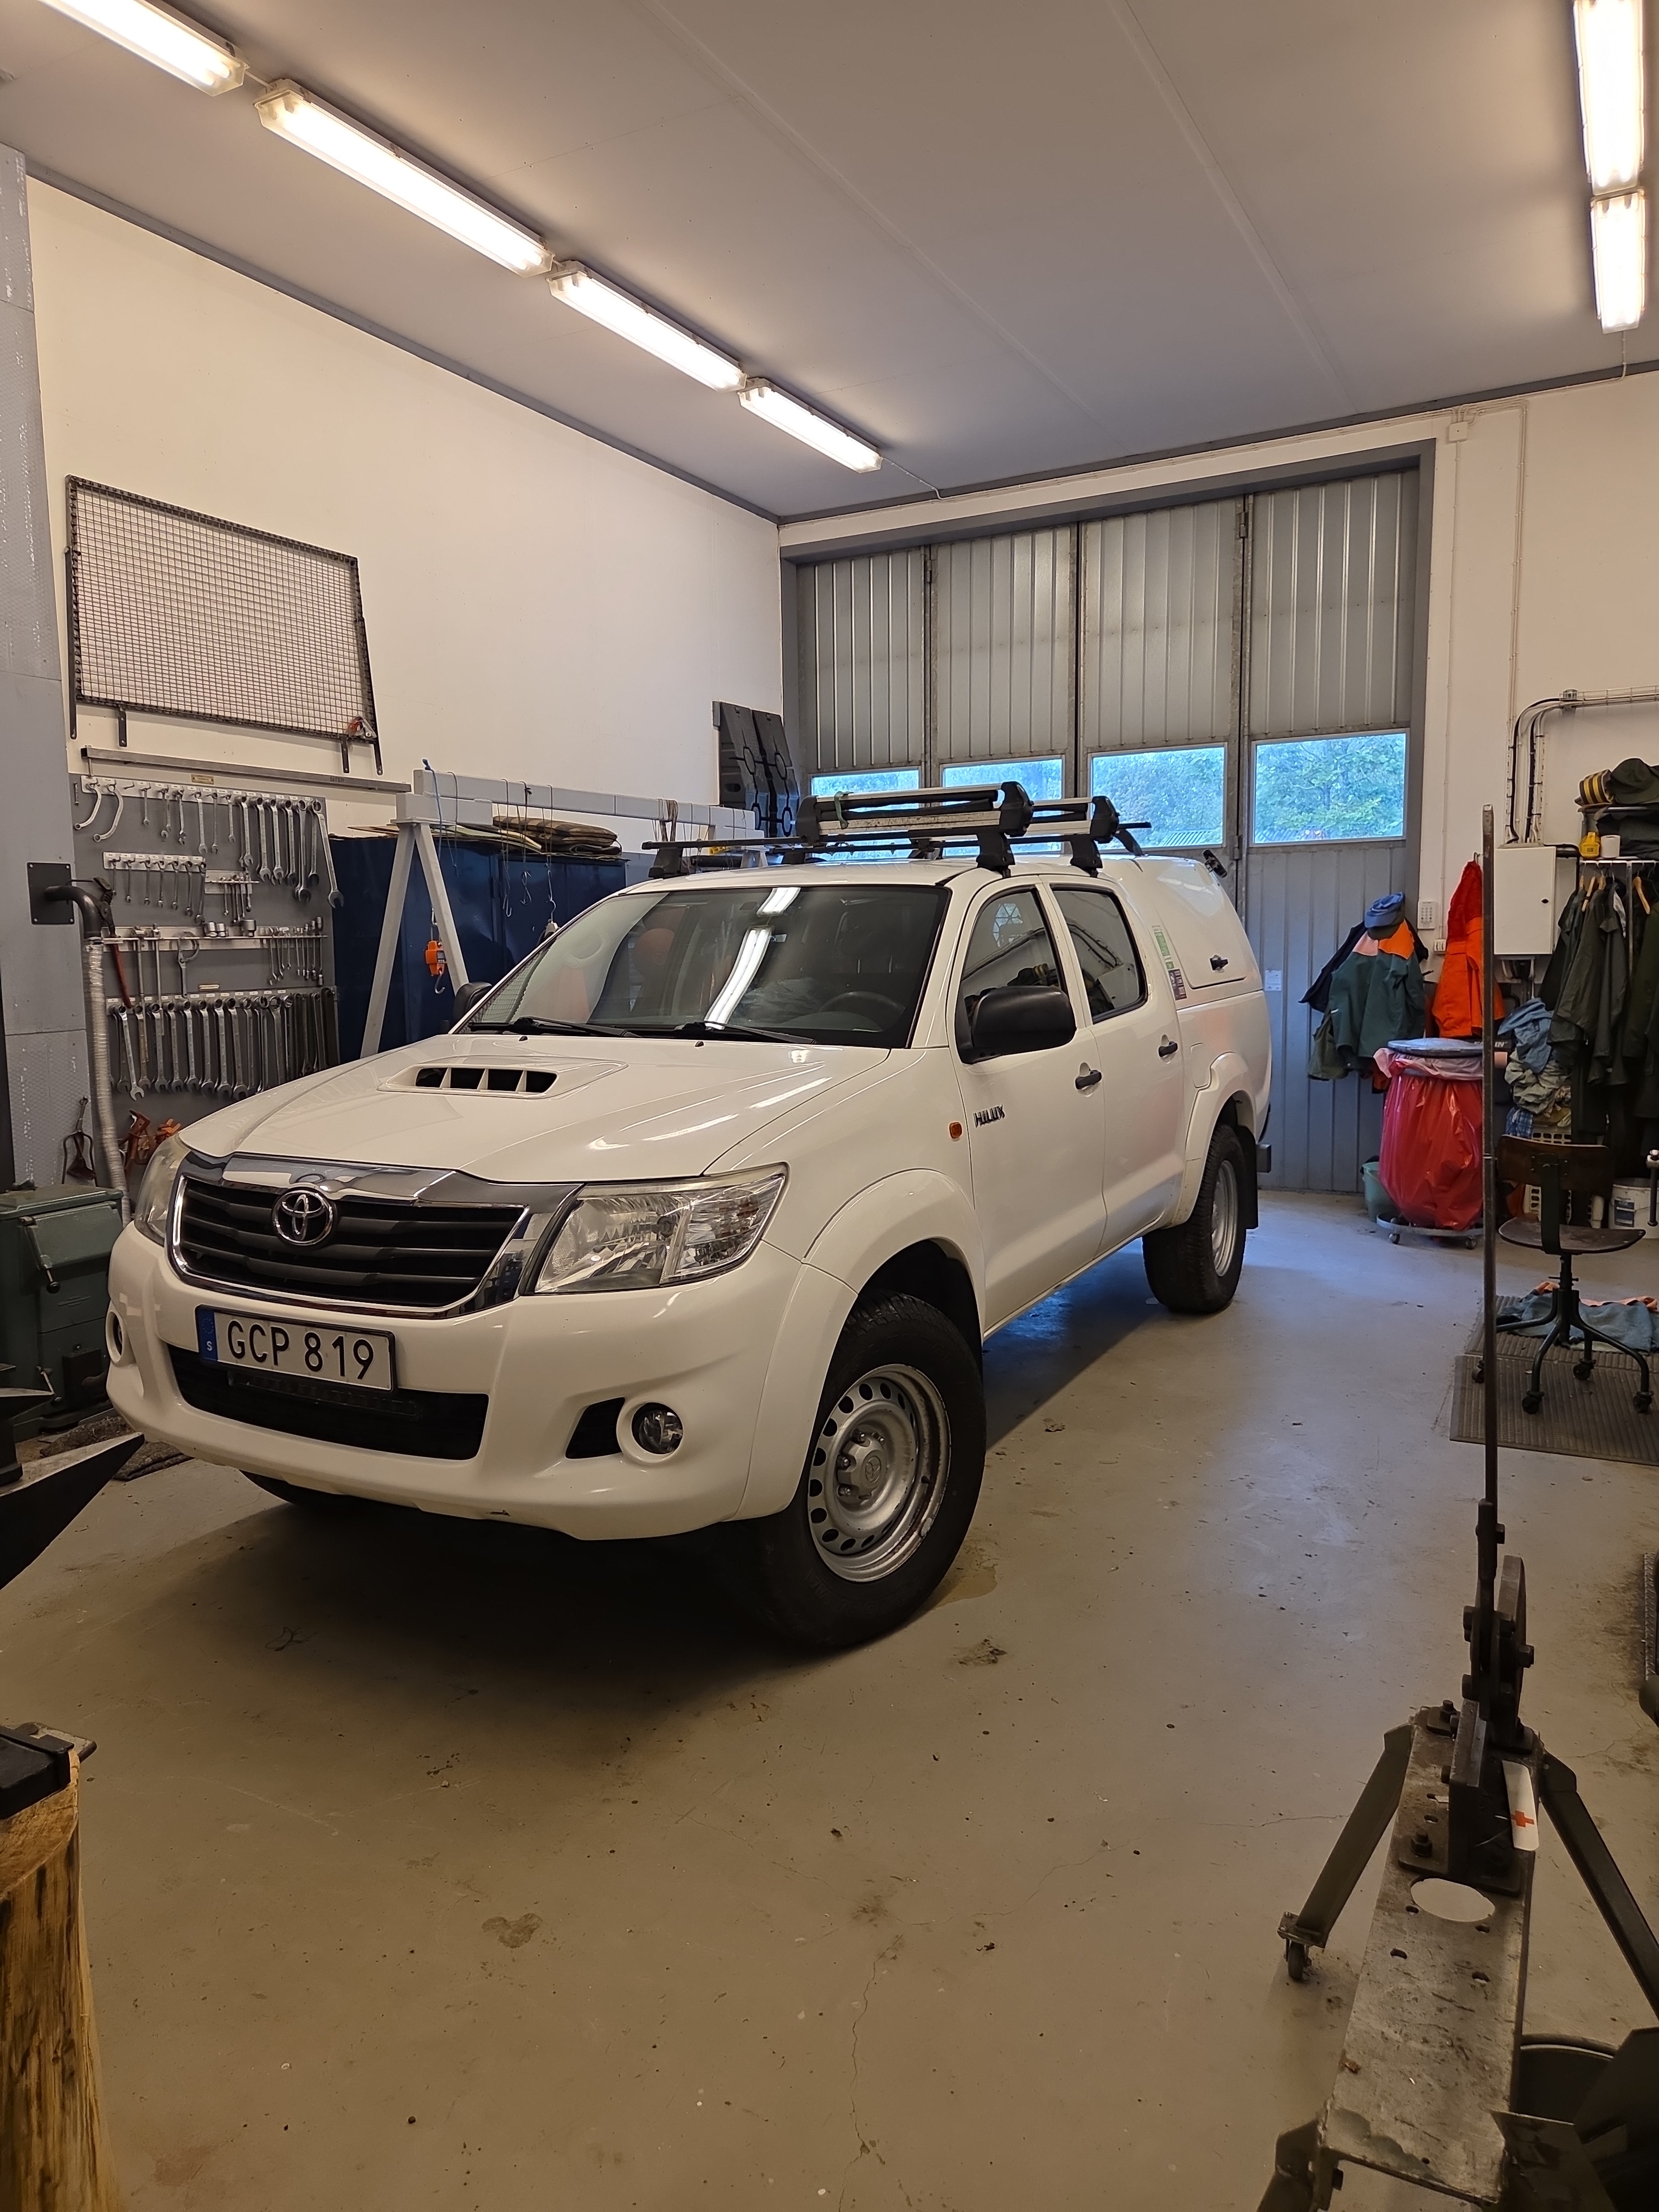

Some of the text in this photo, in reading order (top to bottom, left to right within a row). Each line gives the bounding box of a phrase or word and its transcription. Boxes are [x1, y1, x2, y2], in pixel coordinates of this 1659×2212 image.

[973, 1104, 1005, 1128] HILUX
[207, 1340, 213, 1351] S
[228, 1320, 374, 1380] GCP 819
